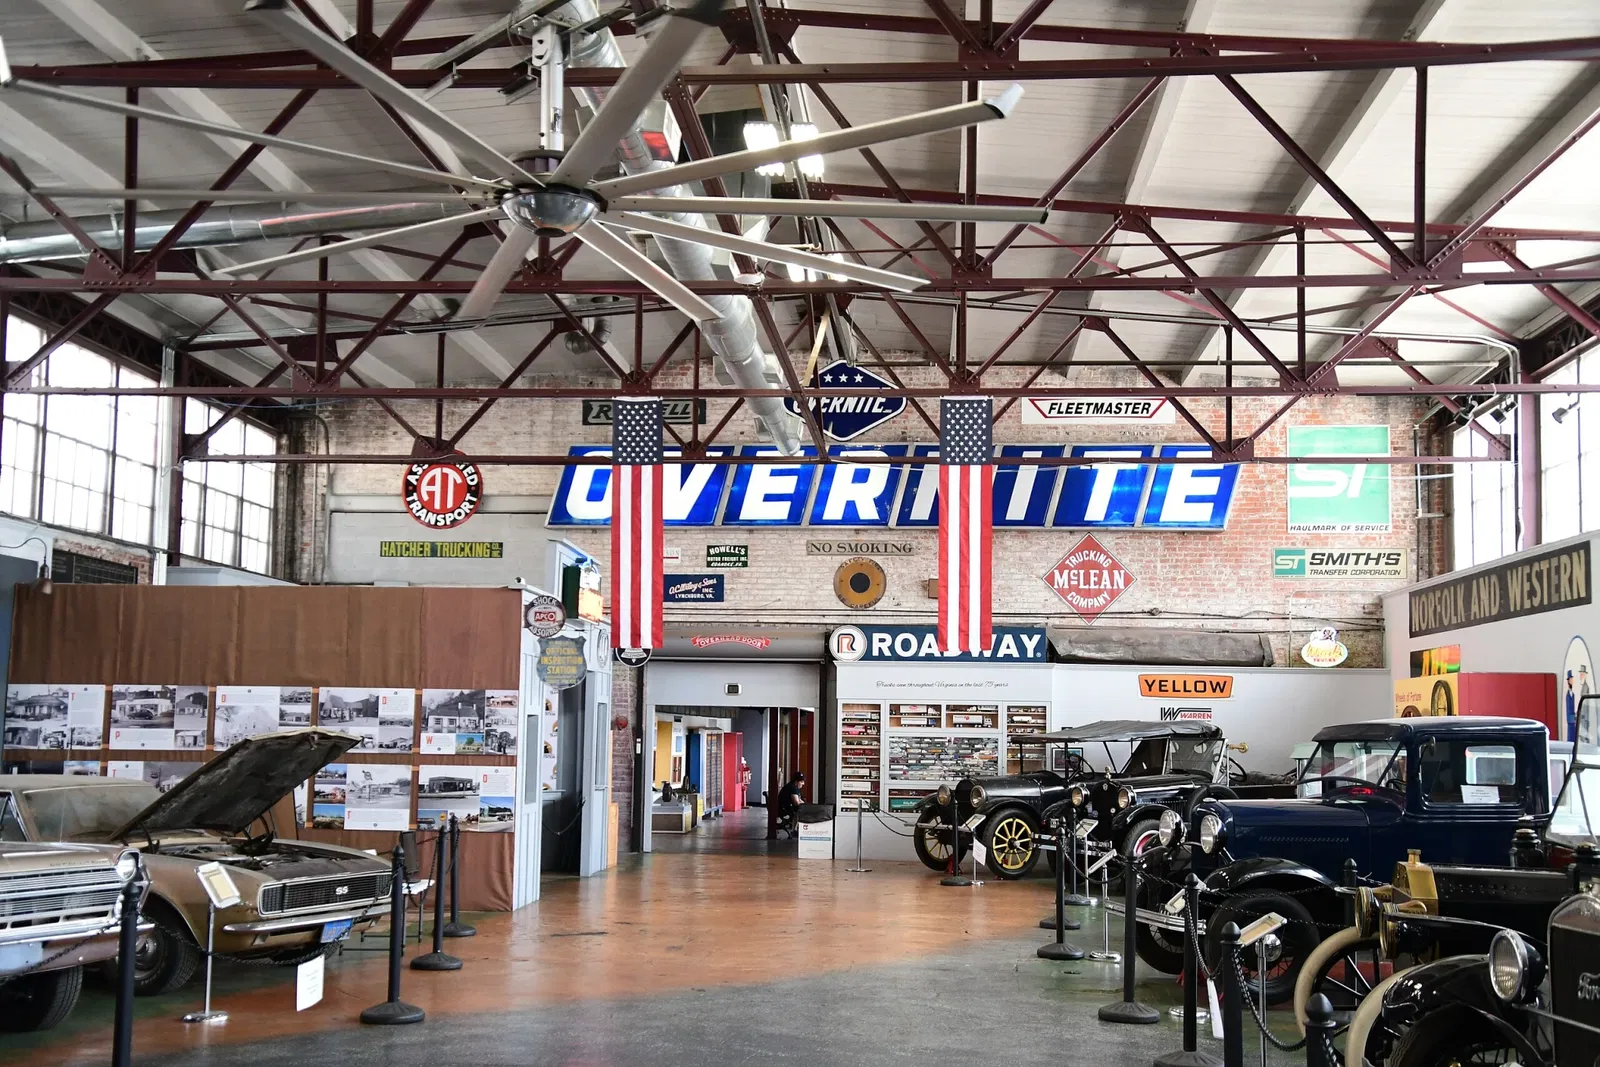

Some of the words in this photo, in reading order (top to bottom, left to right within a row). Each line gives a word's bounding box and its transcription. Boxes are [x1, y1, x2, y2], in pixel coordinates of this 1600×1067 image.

[1048, 402, 1151, 415] FLEETMASTER
[421, 467, 463, 510] AT
[406, 493, 478, 527] TRANSPORT
[381, 541, 431, 557] HATCHER
[435, 542, 491, 557] TRUCKING
[709, 546, 746, 555] HOWELL'S
[810, 543, 832, 553] NO
[836, 542, 913, 553] SMOKING
[1065, 550, 1112, 568] TRUCKING
[1275, 556, 1304, 569] ST
[1309, 553, 1401, 566] SMITH'S
[1412, 583, 1466, 632] NORFOLK
[1471, 574, 1500, 620] AND
[1507, 550, 1587, 612] WESTERN
[533, 597, 557, 606] SHOCK
[1067, 591, 1110, 609] COMPANY
[535, 612, 556, 621] APCO
[529, 625, 561, 636] ABSORBER
[700, 635, 740, 646] OVERHEAD
[742, 637, 762, 647] DOOR
[541, 656, 583, 664] INSPECTION
[547, 666, 577, 674] STATION
[1144, 679, 1227, 693] YELLOW
[335, 886, 349, 895] SS
